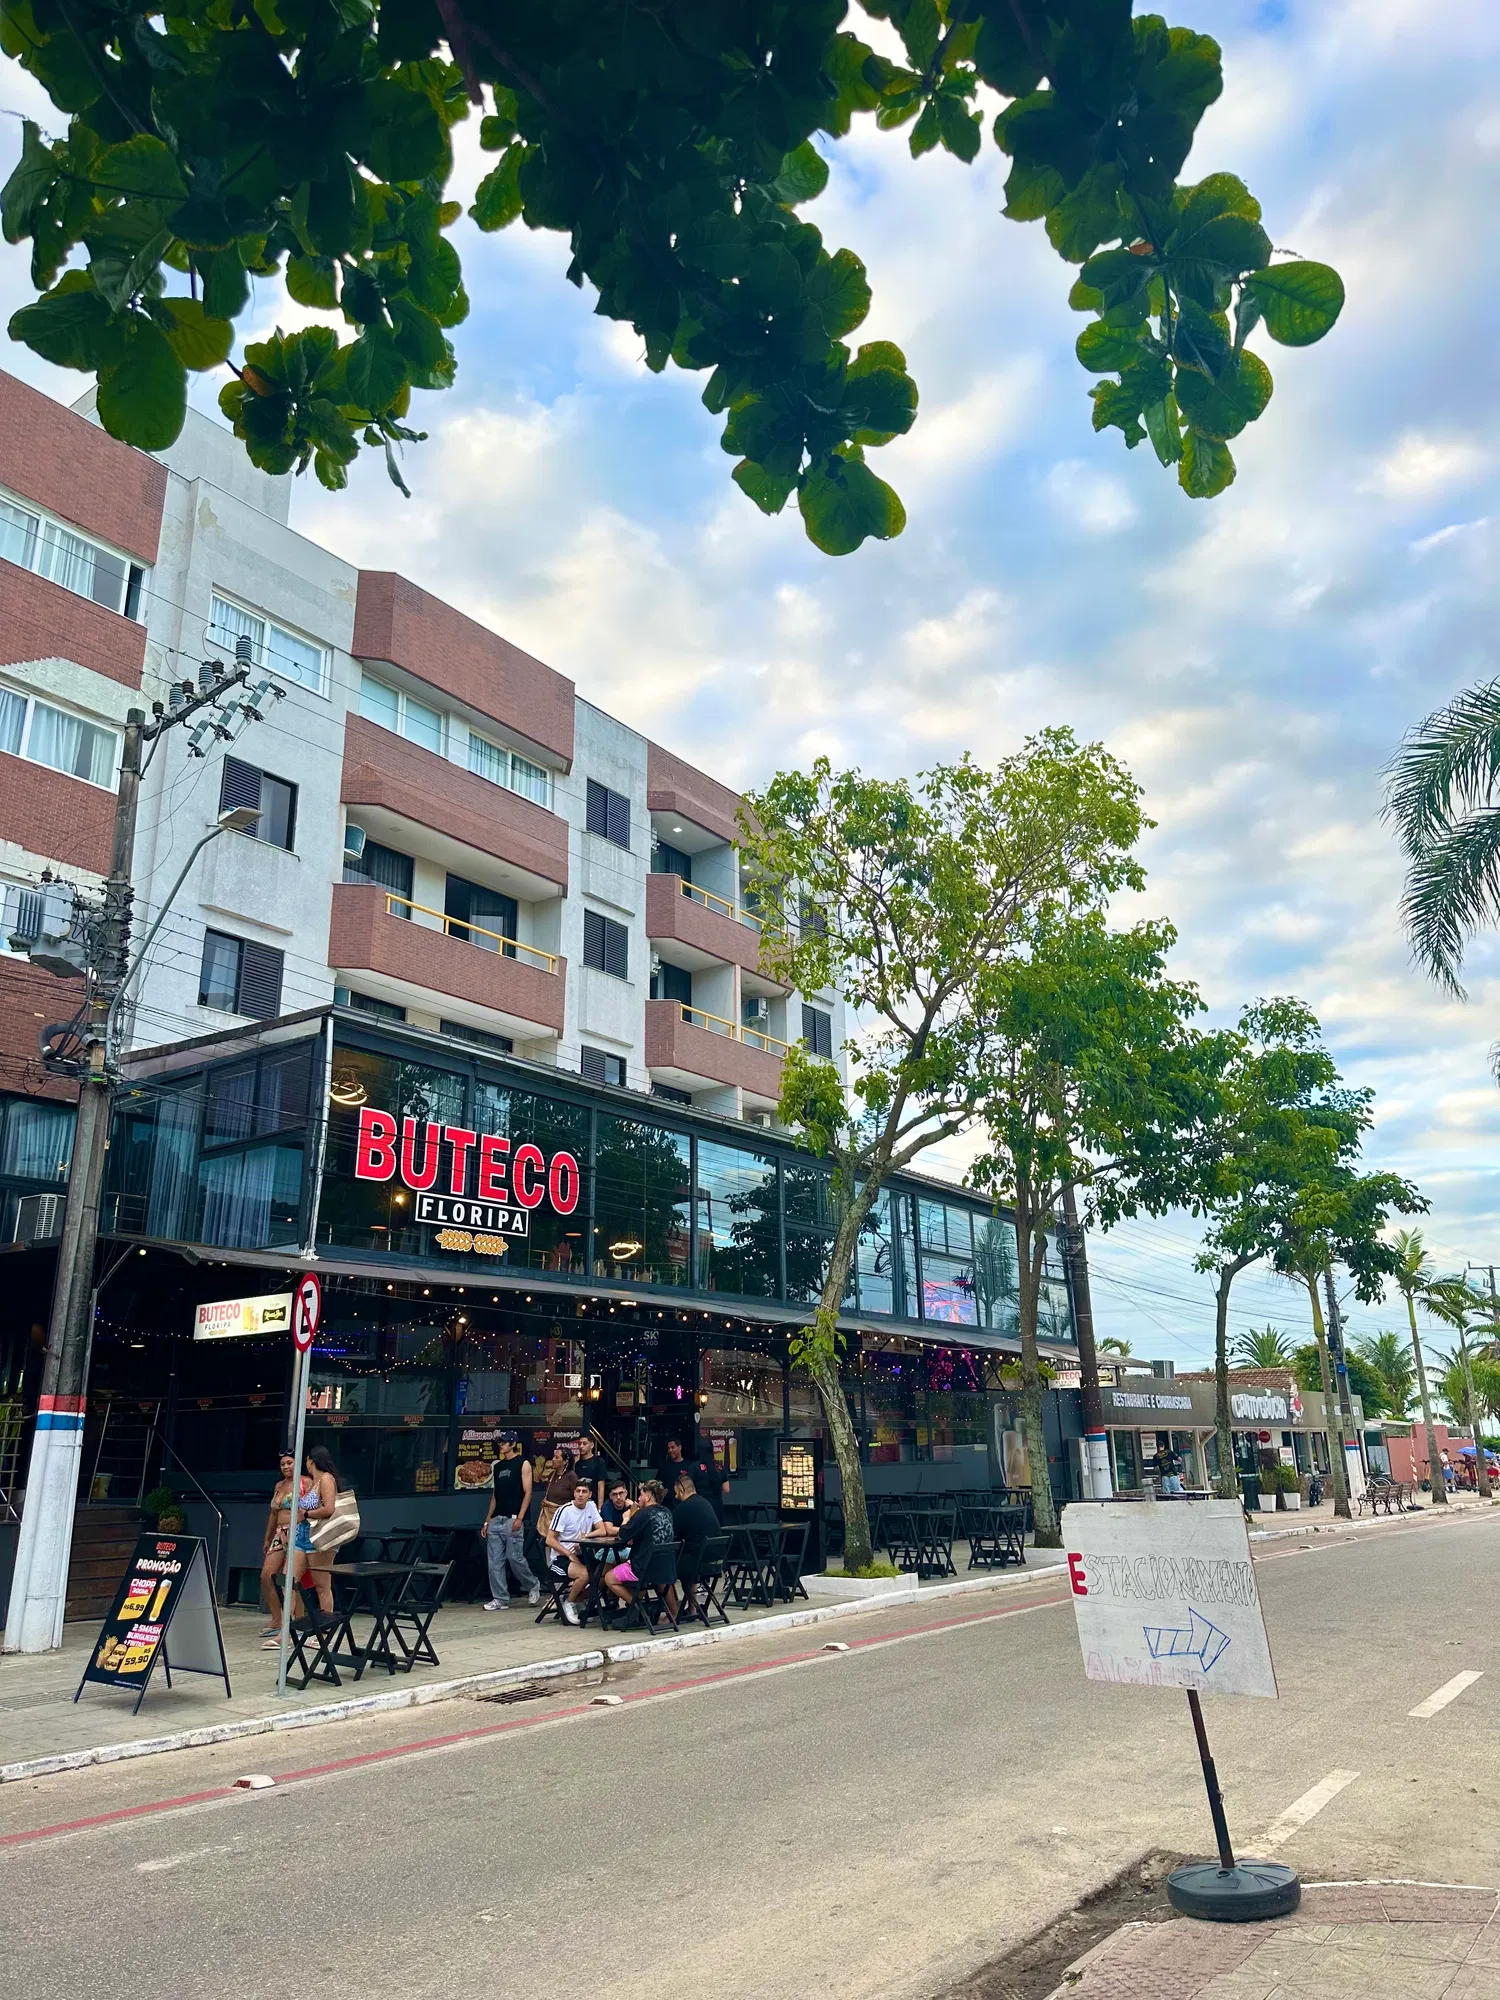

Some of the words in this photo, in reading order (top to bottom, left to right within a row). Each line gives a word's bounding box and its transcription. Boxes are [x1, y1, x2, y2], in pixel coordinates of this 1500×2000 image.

[355, 1106, 580, 1215] BUTECO
[420, 1197, 524, 1232] FLORIPA
[199, 1303, 240, 1323] BUTECO
[205, 1322, 231, 1330] FLORIPA
[1055, 1371, 1080, 1380] UTECO
[1112, 1392, 1150, 1408] RESTAURANTE
[1151, 1395, 1155, 1408] E
[1156, 1395, 1192, 1410] CHURRASCARIA
[156, 1541, 177, 1552] BUTECO
[136, 1558, 181, 1576] PROMOÇÃO
[131, 1578, 157, 1588] CHOPP
[1068, 1553, 1259, 1606] ESTACIONAMENTO
[132, 1623, 138, 1631] 2
[137, 1625, 162, 1634] SMASH
[124, 1655, 149, 1666] 59,90
